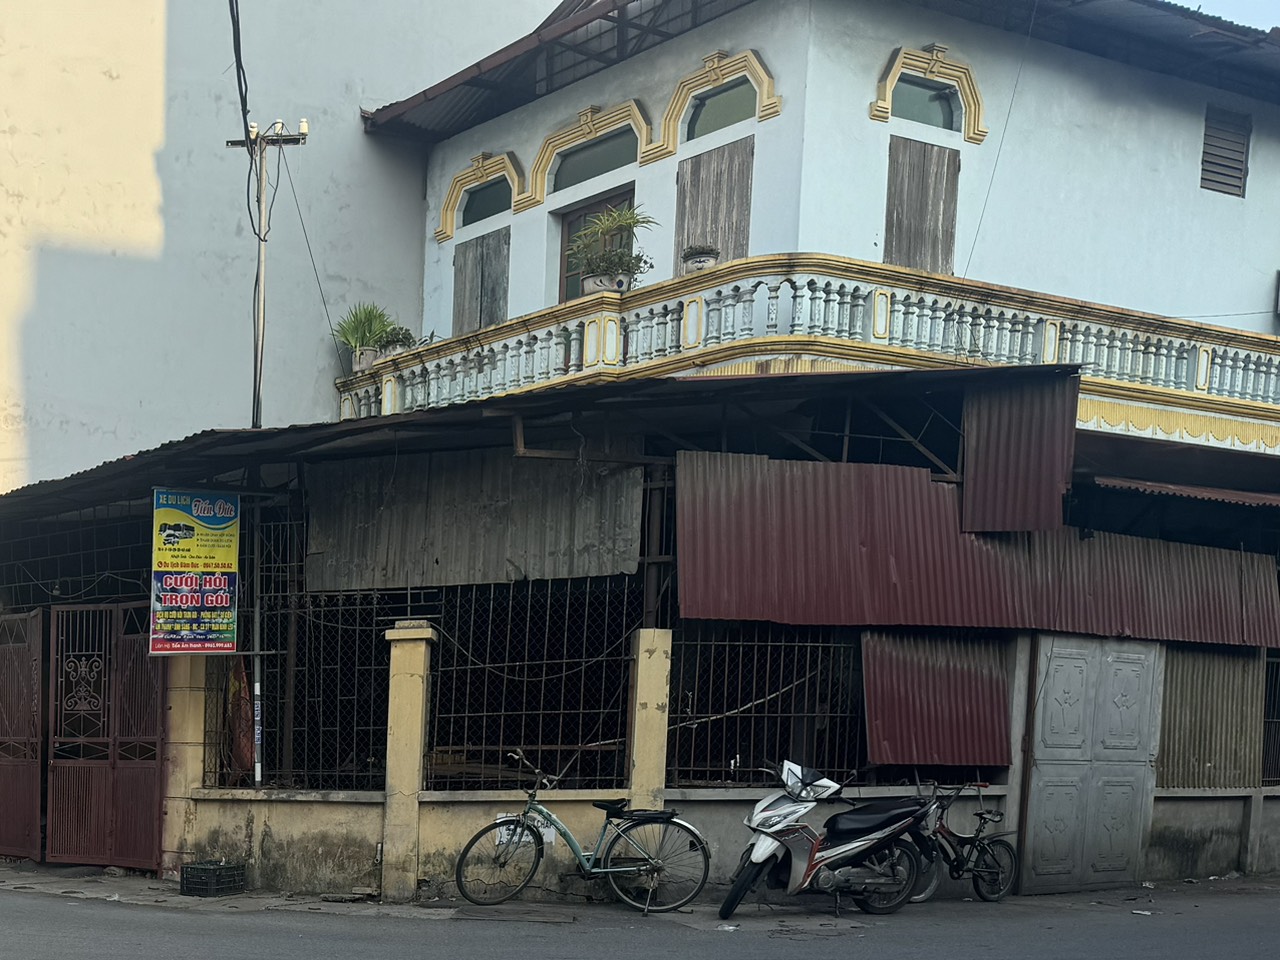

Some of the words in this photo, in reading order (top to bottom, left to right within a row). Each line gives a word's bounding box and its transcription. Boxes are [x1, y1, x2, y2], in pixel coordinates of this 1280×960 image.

[192, 498, 214, 517] Tiến
[214, 499, 235, 517] Đức
[163, 573, 199, 589] CƯỚI
[203, 572, 228, 589] HỎI
[161, 593, 201, 609] TRỌN
[204, 590, 230, 606] GÓI
